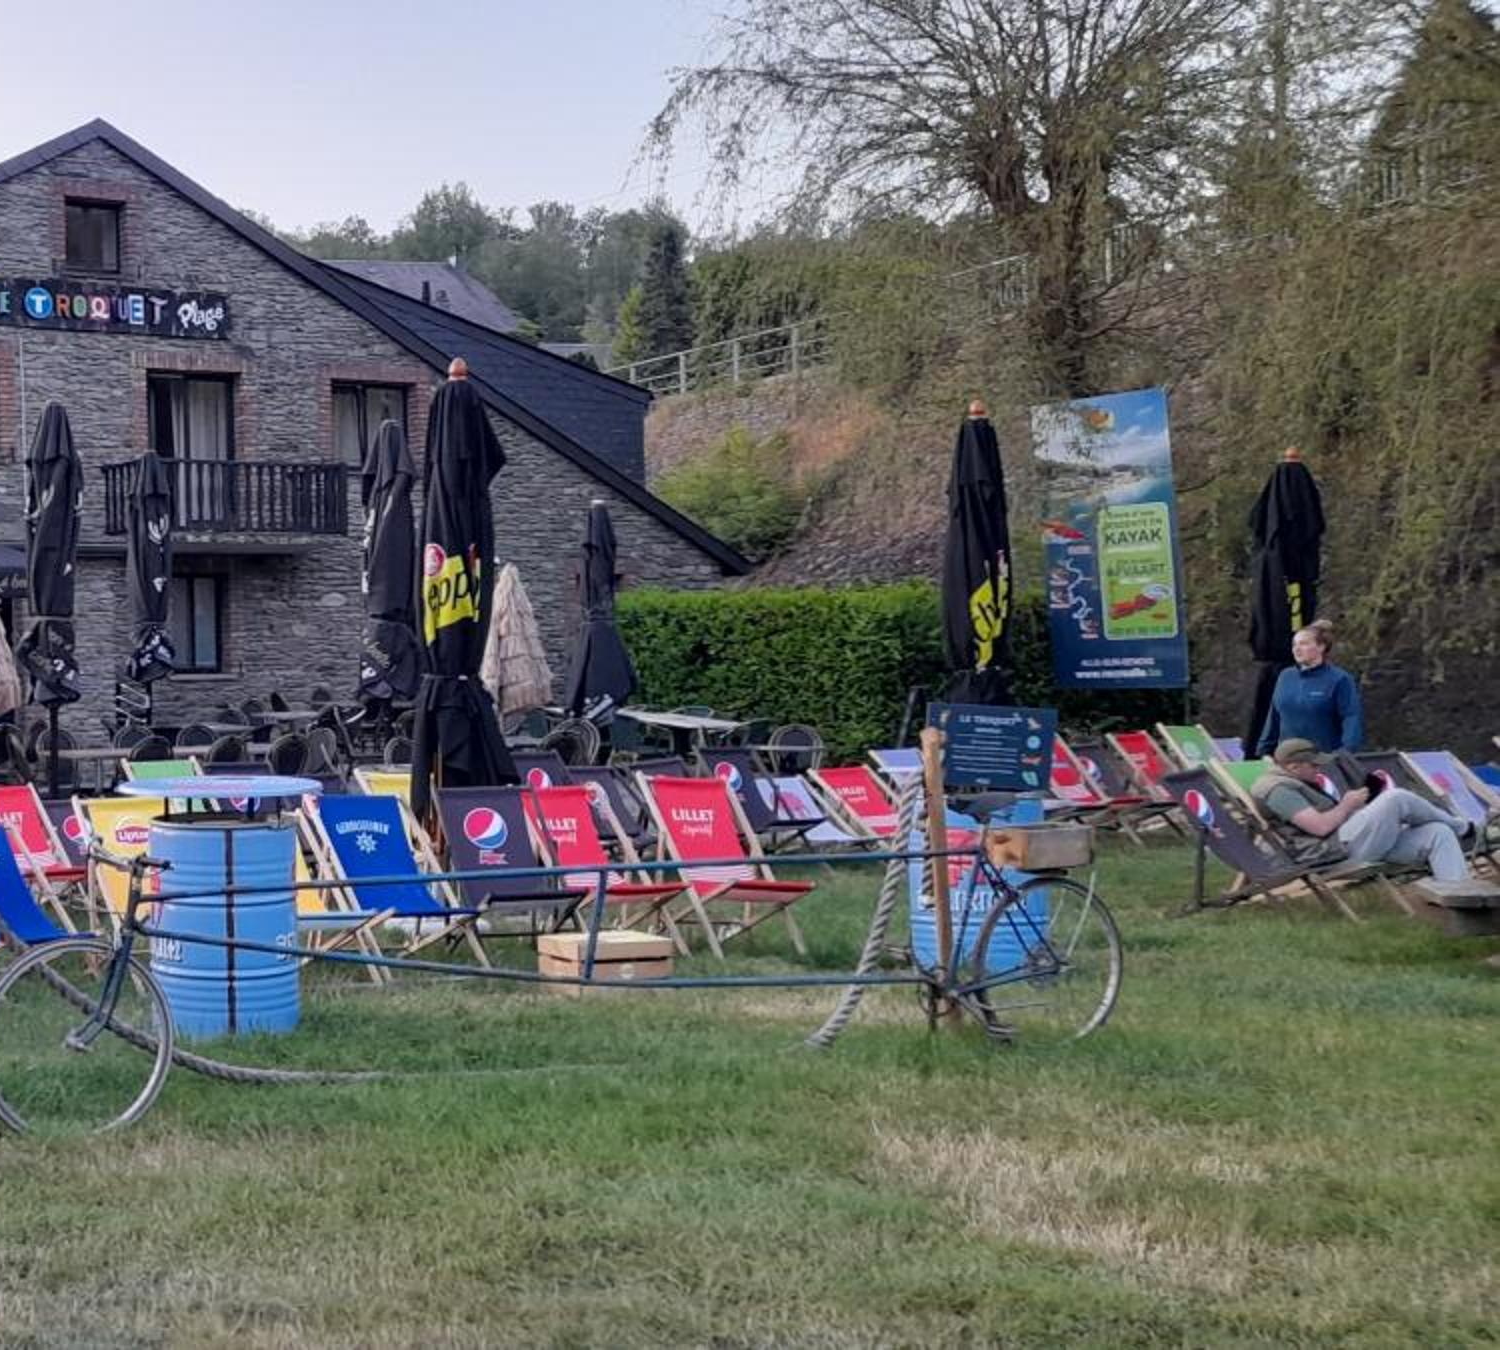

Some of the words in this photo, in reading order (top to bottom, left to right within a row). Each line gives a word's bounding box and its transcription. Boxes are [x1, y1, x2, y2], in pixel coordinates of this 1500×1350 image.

[24, 288, 168, 325] TROQUET
[176, 299, 225, 332] Plage
[1105, 528, 1162, 545] KAYAK
[1106, 563, 1165, 577] AFVAART
[671, 808, 714, 822] LILLET
